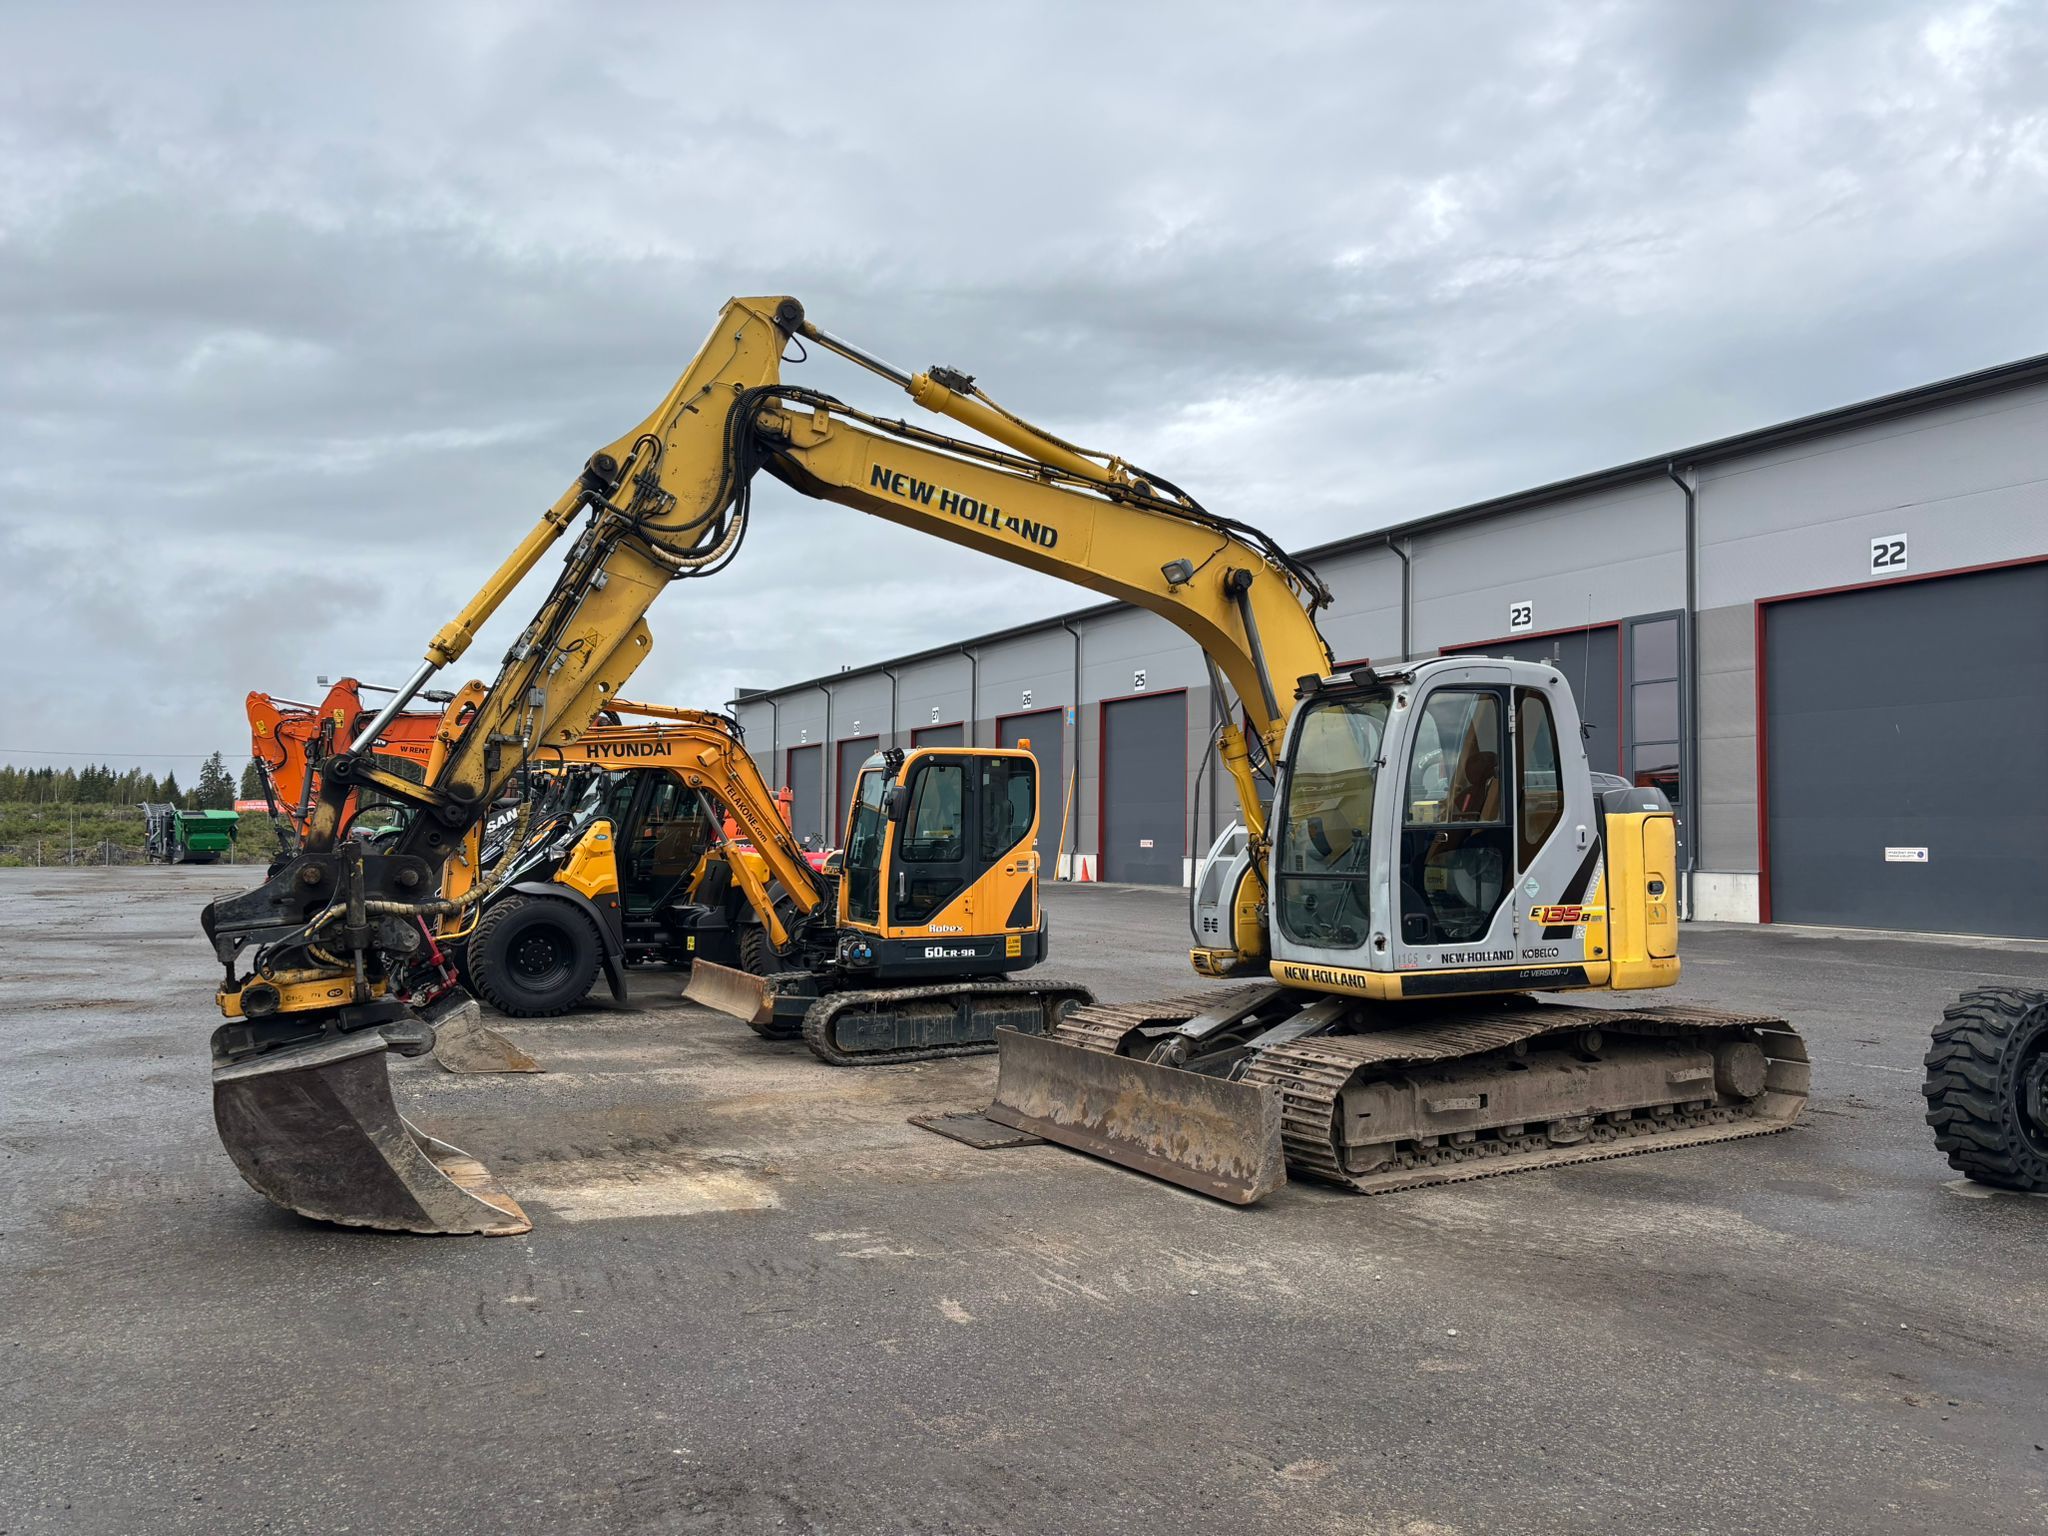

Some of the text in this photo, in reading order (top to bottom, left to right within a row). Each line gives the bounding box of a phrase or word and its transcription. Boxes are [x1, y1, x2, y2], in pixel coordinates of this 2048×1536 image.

[870, 464, 1058, 549] NEW HOLLAND
[1873, 541, 1906, 568] 22
[1511, 606, 1532, 627] 23
[1135, 674, 1145, 687] 25
[1023, 693, 1032, 705] 26
[931, 709, 939, 720] 27
[409, 746, 430, 755] RENT
[586, 742, 672, 759] HYUNDAI
[724, 783, 768, 843] TELAKONE.com
[928, 924, 964, 933] Robex
[1441, 950, 1515, 965] NEW HOLLAND
[1521, 948, 1560, 960] KOBELCO
[1284, 966, 1366, 988] NEW HOLLAND
[1519, 970, 1530, 978] LC
